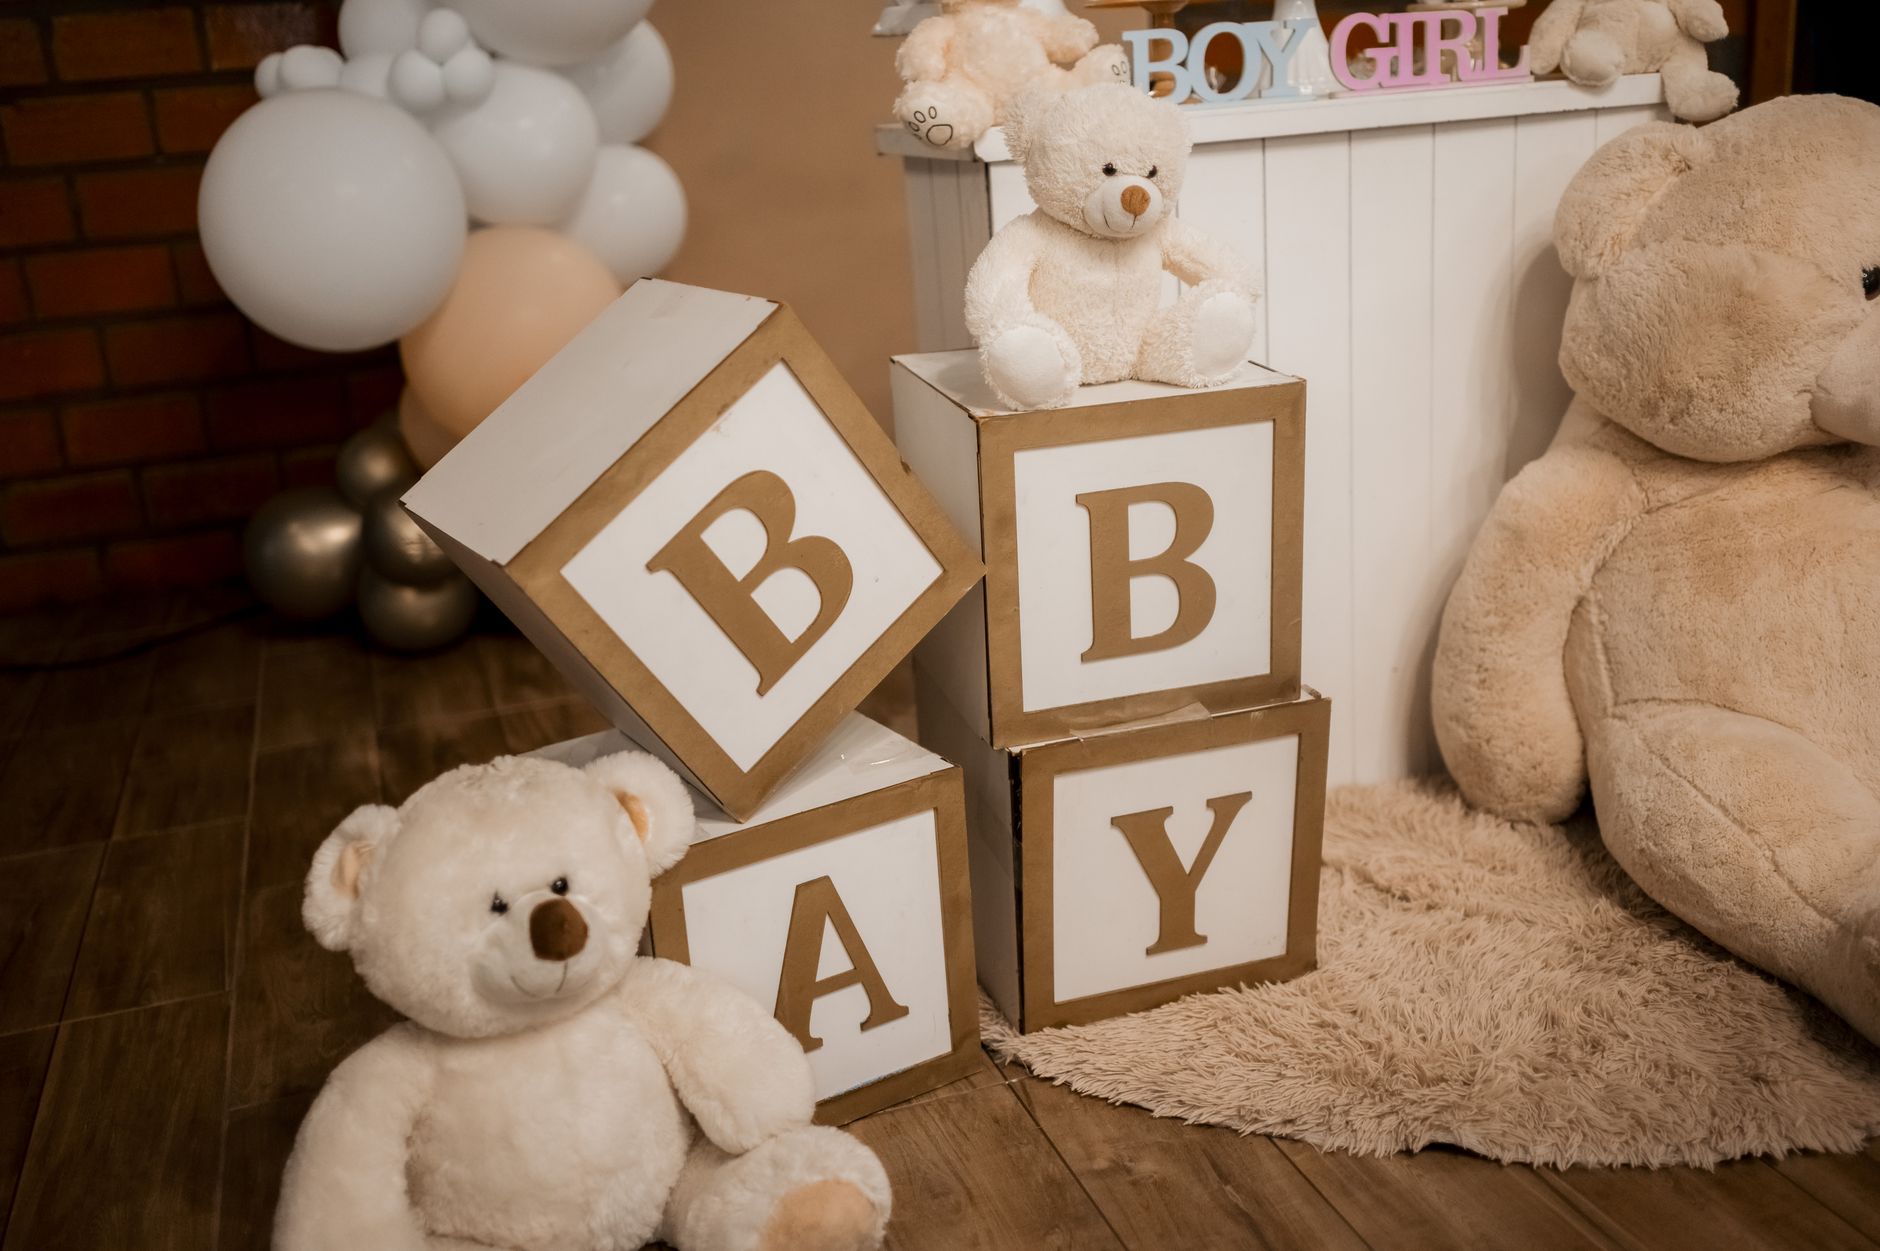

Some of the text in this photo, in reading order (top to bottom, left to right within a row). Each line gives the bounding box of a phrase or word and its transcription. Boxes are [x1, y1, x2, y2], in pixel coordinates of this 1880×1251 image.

[1122, 8, 1530, 100] BOY GIRL
[646, 469, 853, 697] B
[1075, 481, 1217, 663] B
[1110, 791, 1252, 956] Y
[774, 875, 909, 1053] A
